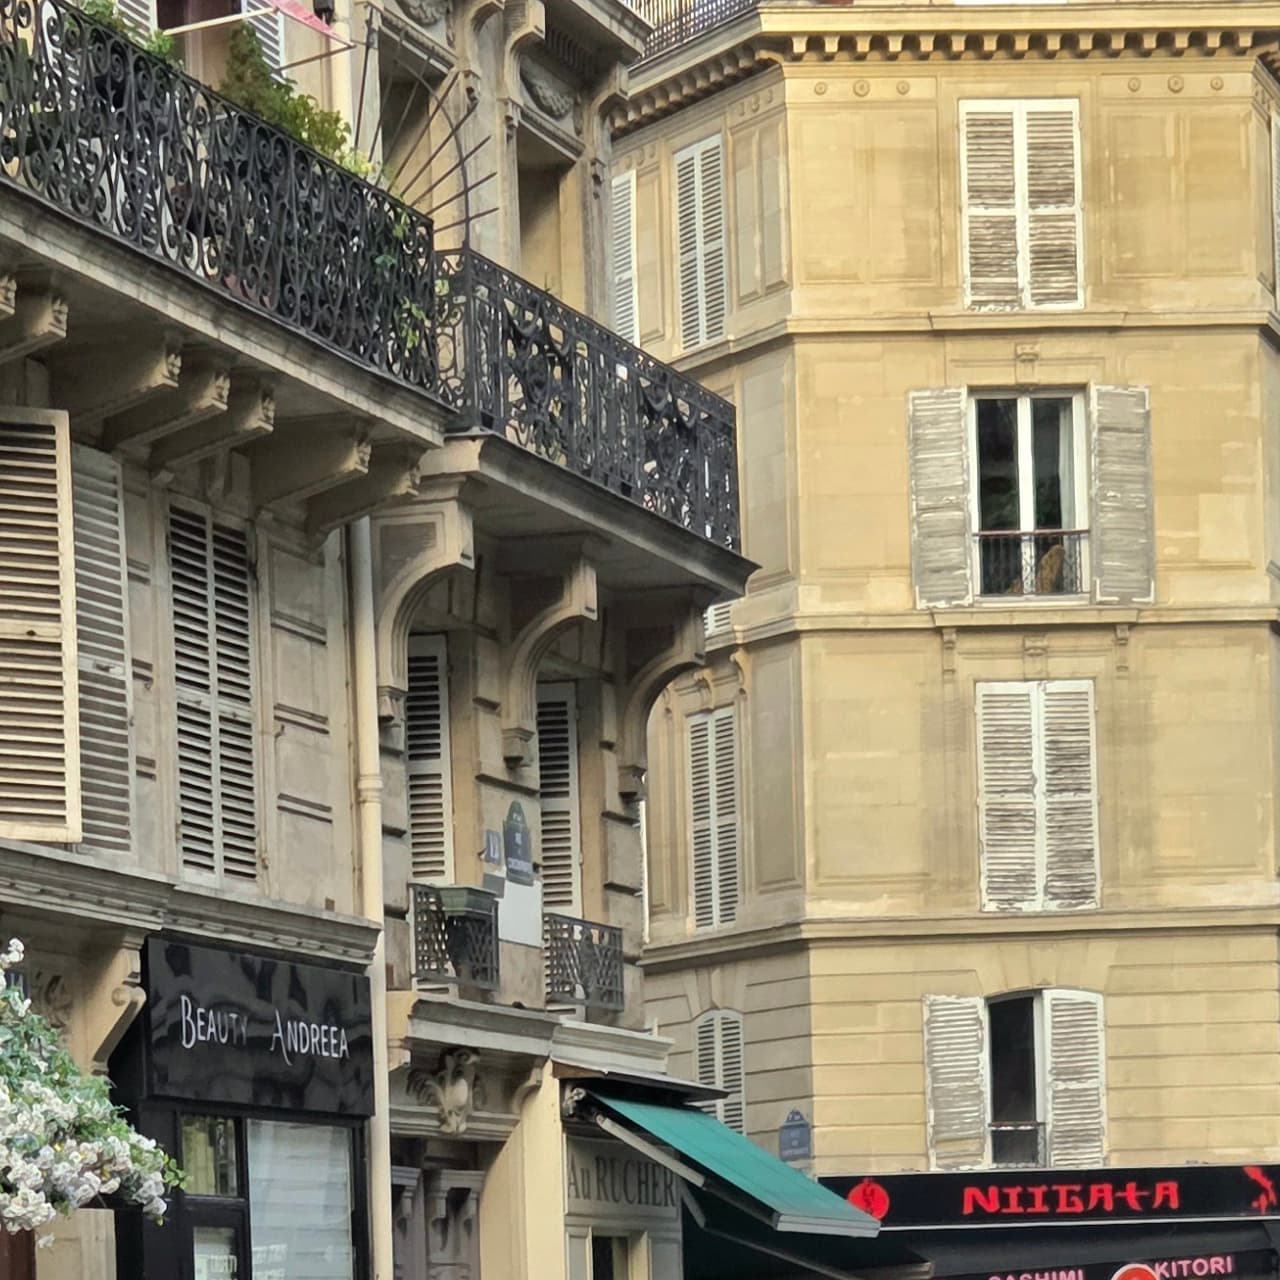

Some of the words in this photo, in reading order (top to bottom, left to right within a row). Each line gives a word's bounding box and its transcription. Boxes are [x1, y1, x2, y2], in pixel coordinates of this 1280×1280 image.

[180, 994, 248, 1049] BEAUTY
[269, 1008, 351, 1066] ANDREEA
[1154, 1255, 1233, 1279] KITORI
